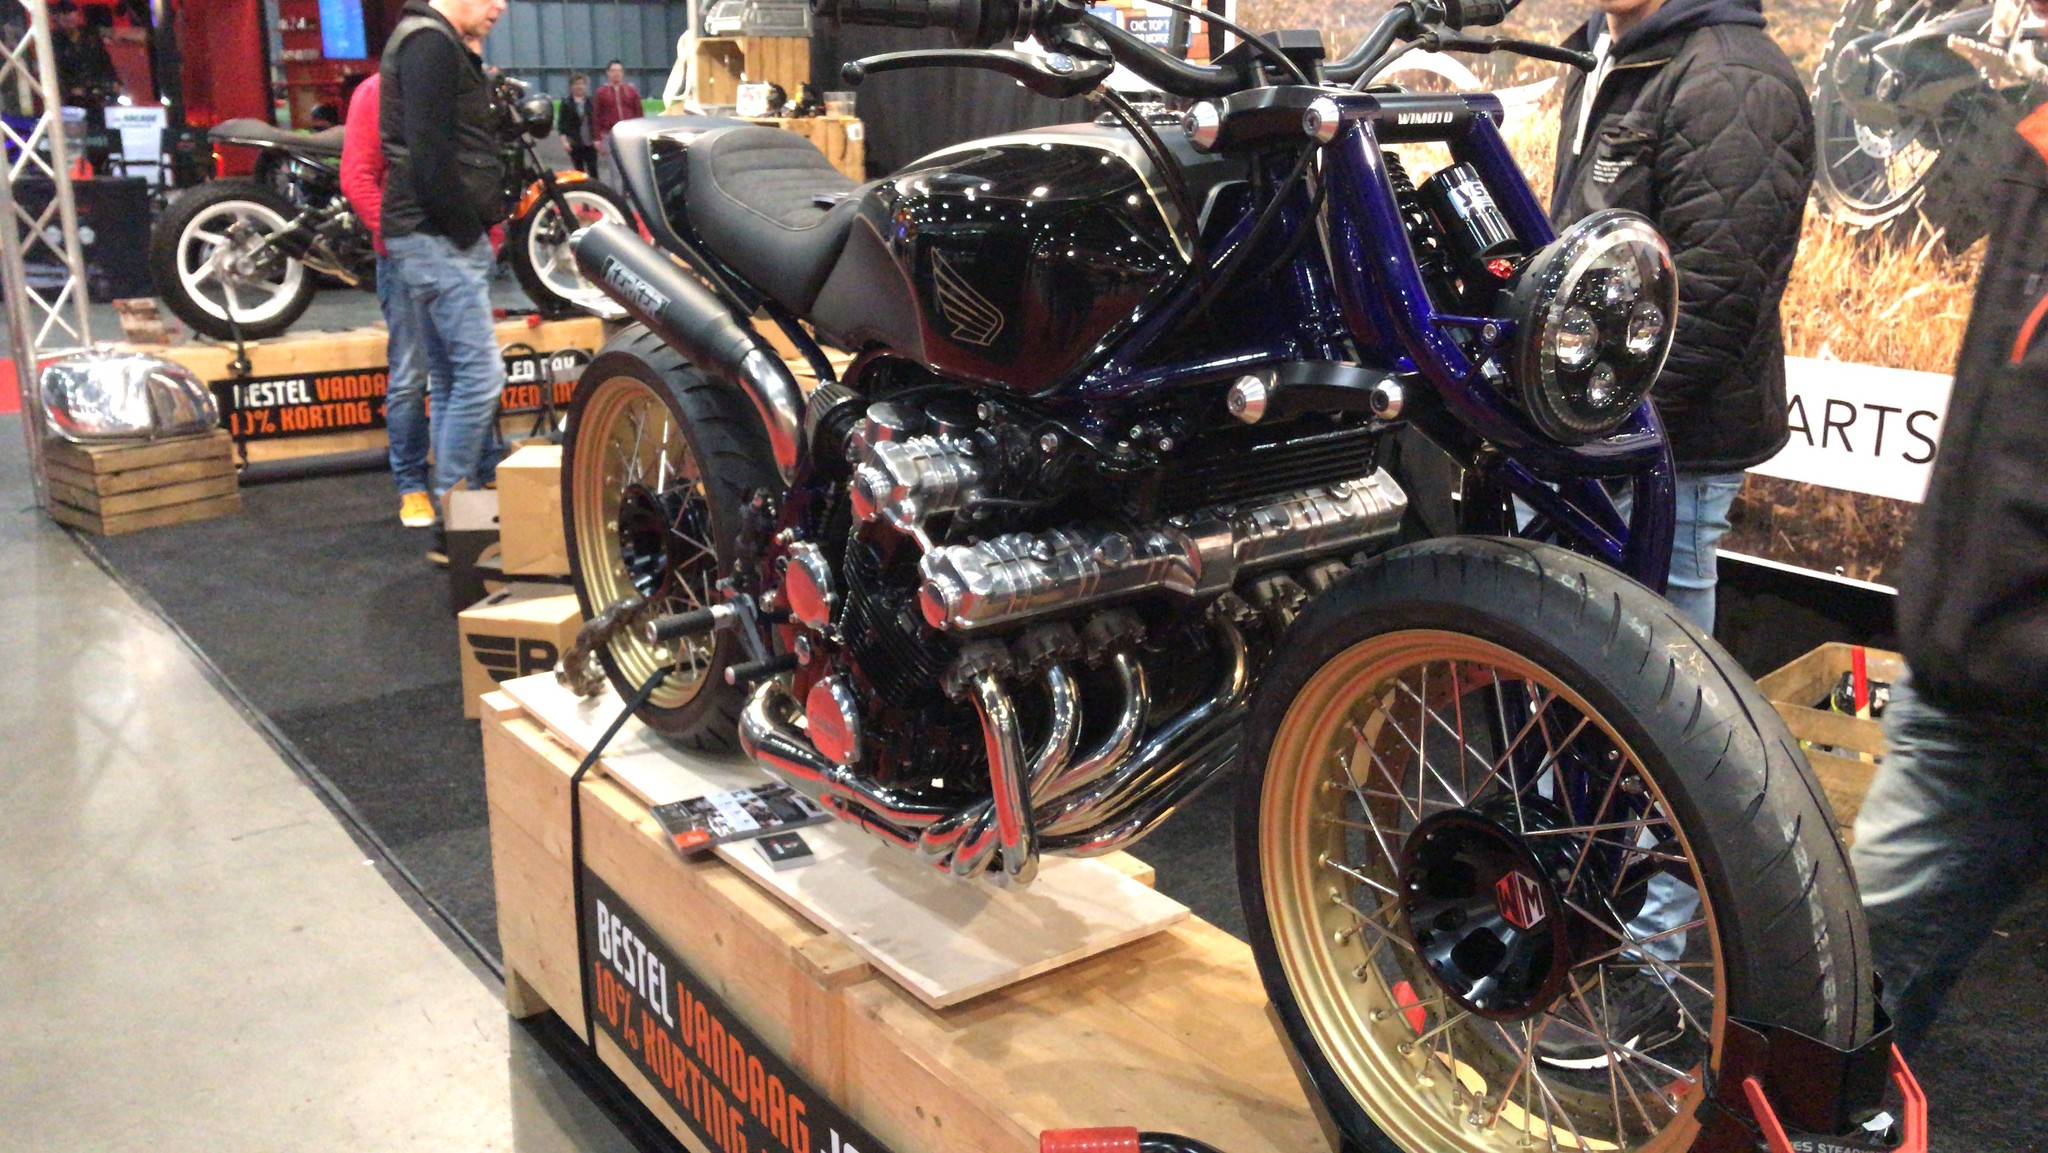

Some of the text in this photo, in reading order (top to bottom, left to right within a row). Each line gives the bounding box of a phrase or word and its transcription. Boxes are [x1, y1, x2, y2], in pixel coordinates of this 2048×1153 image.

[1130, 20, 1147, 32] CNC
[1397, 111, 1454, 125] WIMOTO
[315, 372, 392, 402] VANDA
[281, 400, 372, 432] KORTING
[596, 899, 811, 1153] BESTEL VANDAAG
[595, 961, 748, 1153] 10% KORTING
